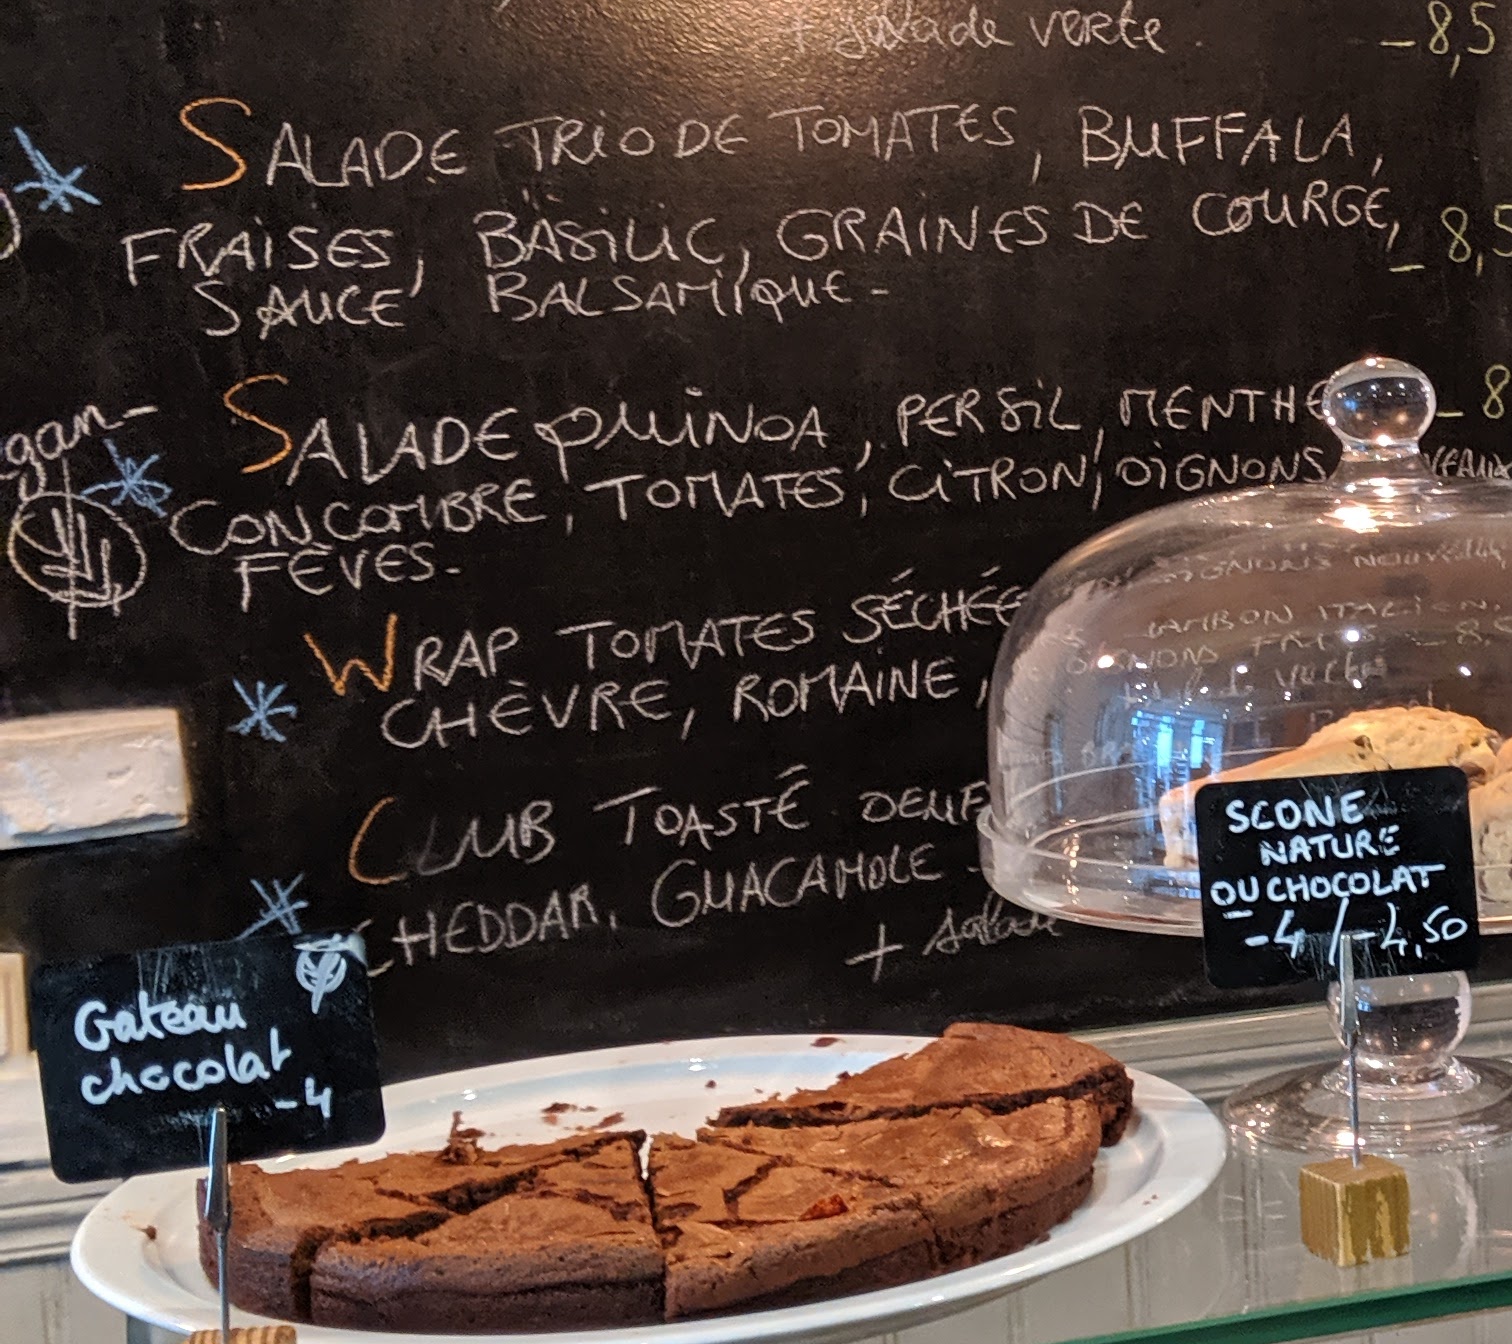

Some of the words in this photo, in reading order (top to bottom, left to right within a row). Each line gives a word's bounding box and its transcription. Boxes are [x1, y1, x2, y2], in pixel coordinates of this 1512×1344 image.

[180, 97, 467, 191] SALADE
[495, 109, 654, 172] TRIO
[676, 115, 748, 160] DE
[778, 205, 1052, 262] GRAINES
[1074, 201, 1149, 244] DE
[194, 280, 405, 340] SAUCE
[225, 373, 518, 487] SALADE
[1116, 441, 1328, 492] OIGNONS
[305, 613, 519, 697] WRAP
[559, 609, 816, 670] TOMATES
[348, 796, 556, 886] CLUB
[595, 764, 812, 851] TOASTÉ
[1225, 789, 1368, 834] SCONE
[1259, 824, 1401, 866] NATURE
[652, 842, 942, 927] GUACAMOLE
[1210, 874, 1261, 907] OU
[1266, 864, 1447, 903] CHOCOLAT
[74, 990, 248, 1052] Gateau
[81, 1027, 293, 1105] chocolat
